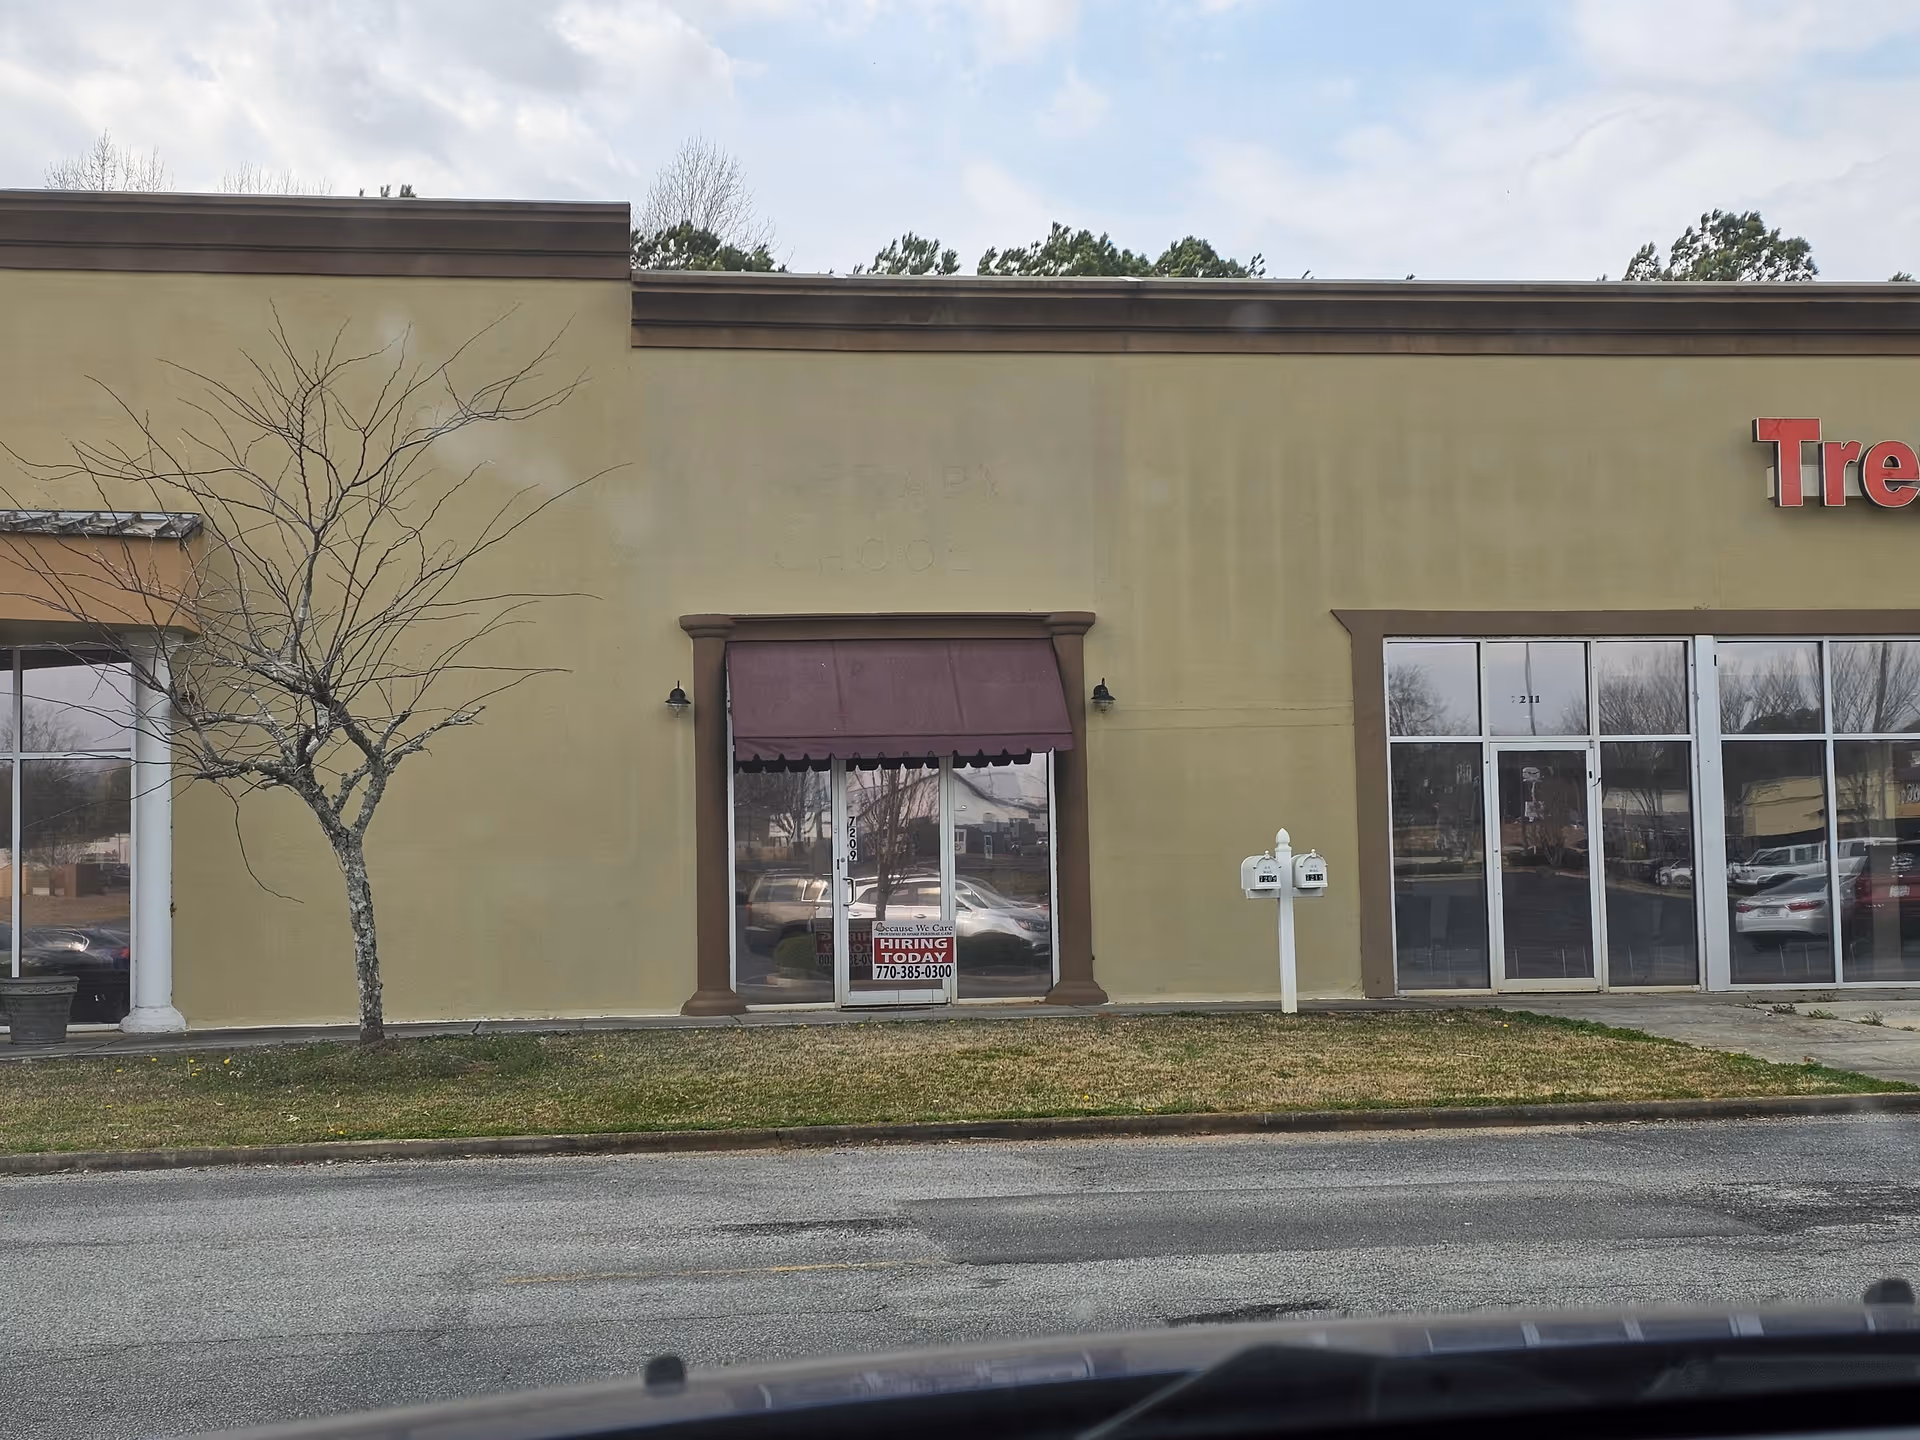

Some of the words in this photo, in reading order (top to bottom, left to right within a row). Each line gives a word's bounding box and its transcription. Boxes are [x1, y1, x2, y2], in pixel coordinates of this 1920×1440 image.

[1752, 417, 1920, 507] Tre
[880, 938, 948, 949] HIRING
[881, 952, 946, 963] TODAY
[876, 965, 952, 978] 770-385-0300
